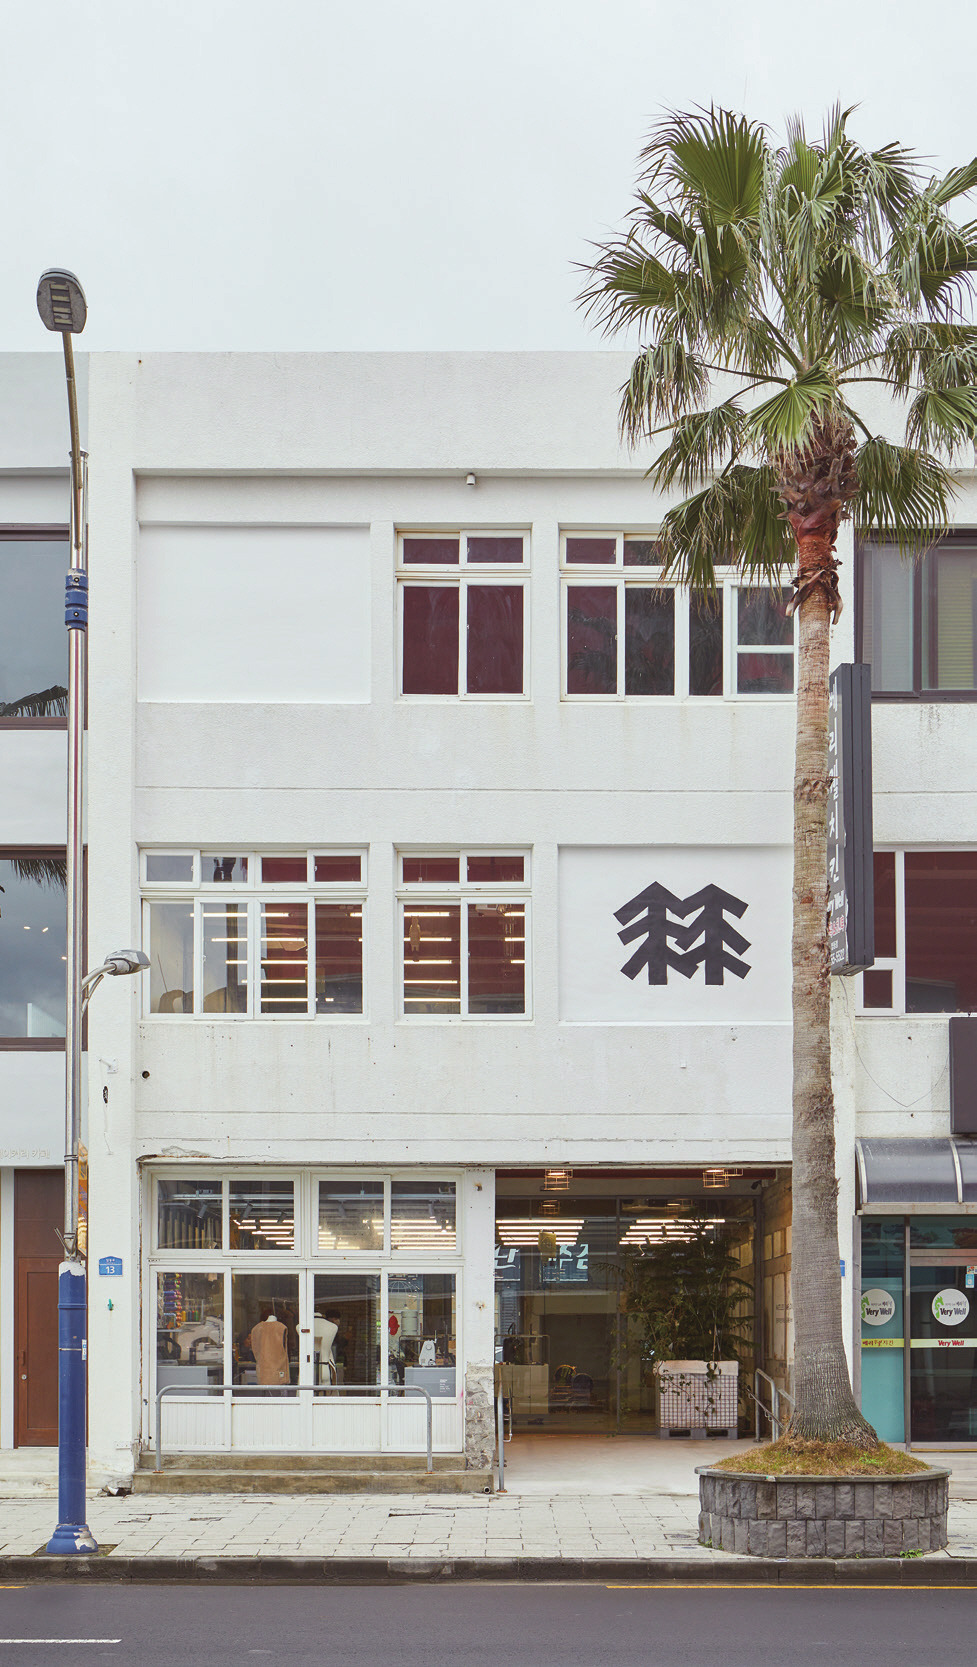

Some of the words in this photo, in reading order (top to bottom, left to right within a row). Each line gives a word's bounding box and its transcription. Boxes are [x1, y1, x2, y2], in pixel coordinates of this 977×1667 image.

[0, 1149, 29, 1160] 이커리
[105, 1266, 115, 1274] 13
[866, 1308, 879, 1317] Very
[940, 1308, 953, 1317] Very
